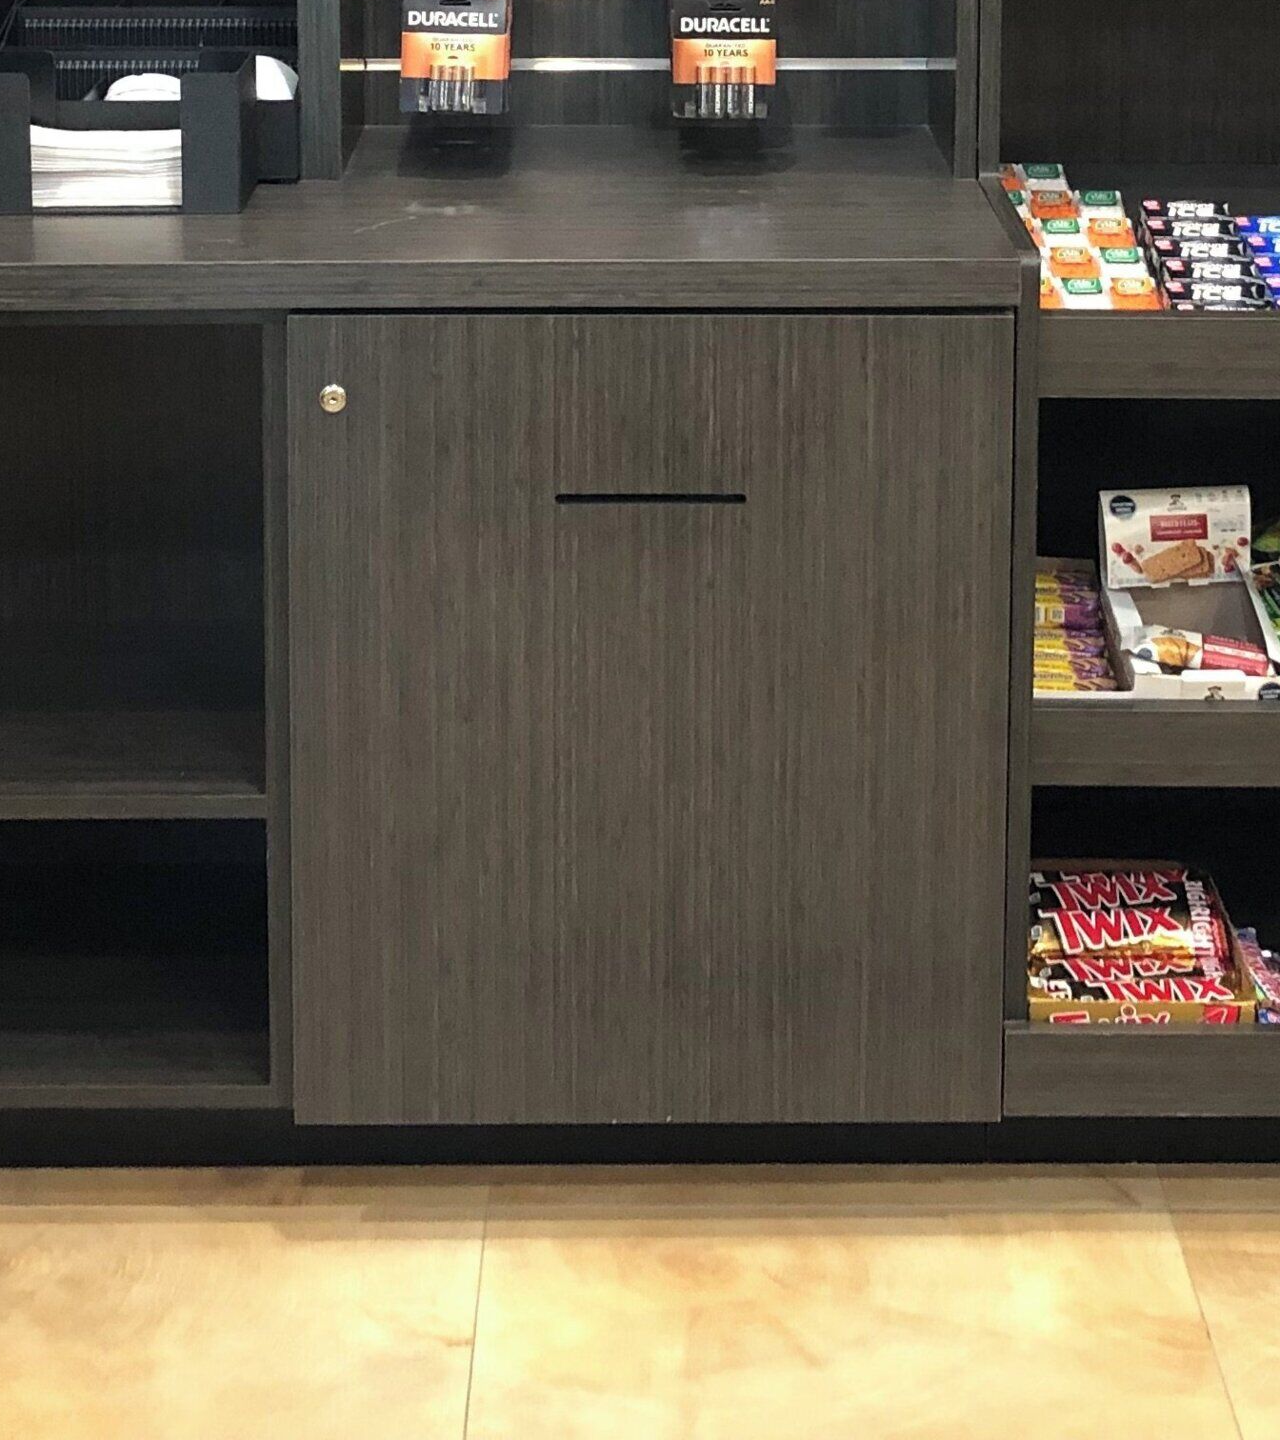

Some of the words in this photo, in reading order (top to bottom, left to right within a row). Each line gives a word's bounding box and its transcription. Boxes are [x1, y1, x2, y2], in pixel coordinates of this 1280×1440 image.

[407, 10, 499, 28] DURACELL
[679, 16, 771, 34] DURACELL
[430, 43, 441, 51] 10
[444, 42, 476, 52] YEARS
[704, 49, 714, 58] 10
[716, 48, 749, 58] YEARS
[1039, 872, 1178, 911] TWIX
[1039, 908, 1183, 954] TWIX
[1086, 975, 1235, 1003] TWIX
